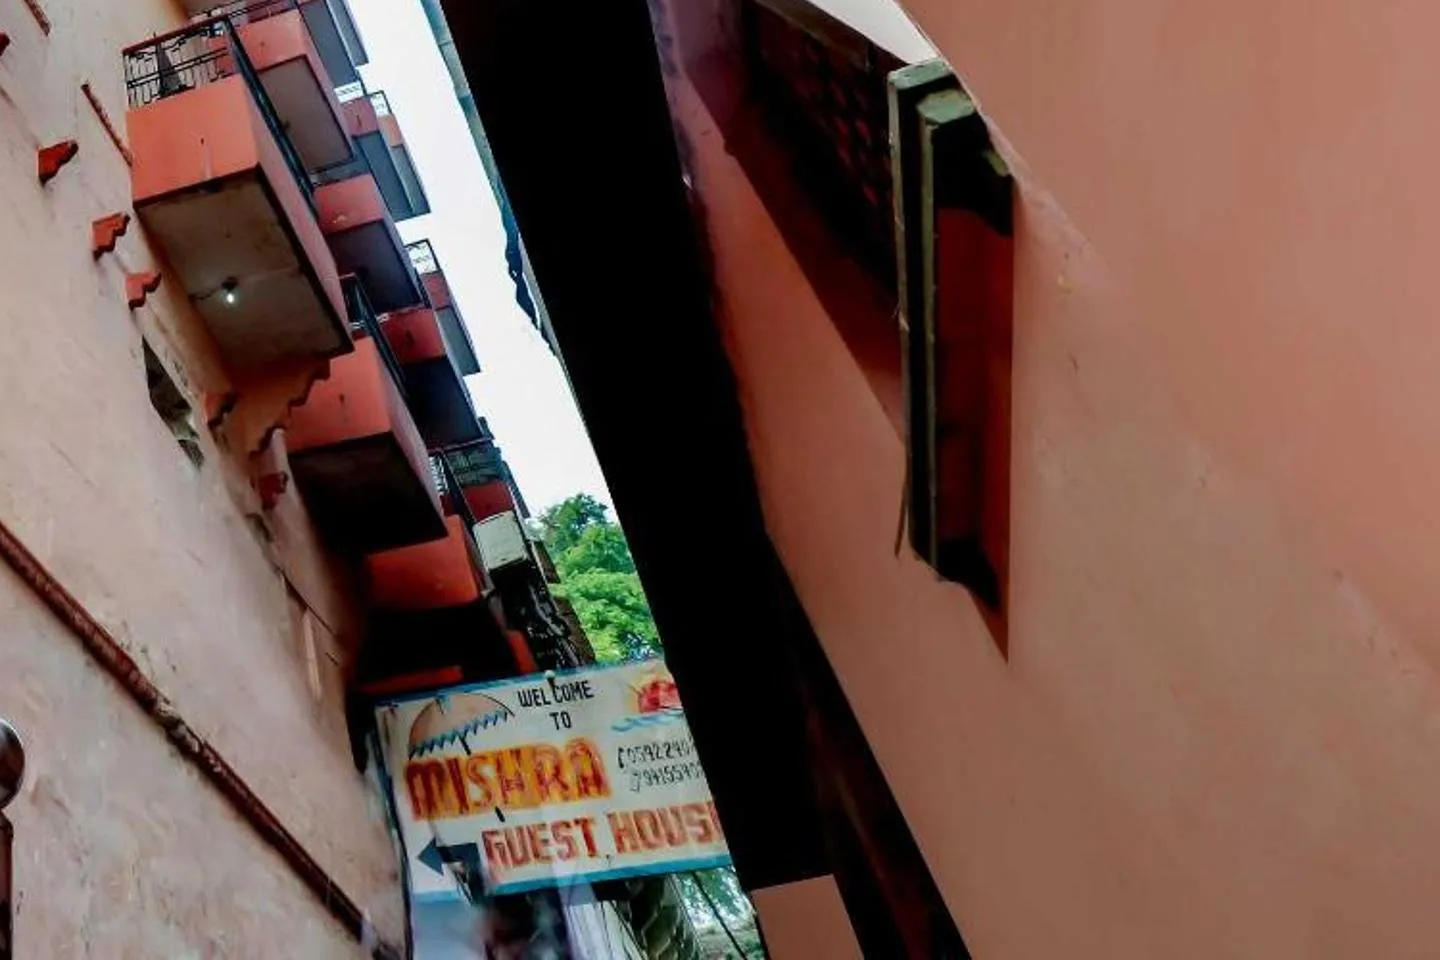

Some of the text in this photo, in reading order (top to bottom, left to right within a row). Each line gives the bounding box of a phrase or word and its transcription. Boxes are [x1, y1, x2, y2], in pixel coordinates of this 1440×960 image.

[517, 680, 594, 708] WELCOME
[550, 712, 572, 730] TO
[405, 738, 611, 821] MISHRA
[481, 817, 597, 868] GUEST
